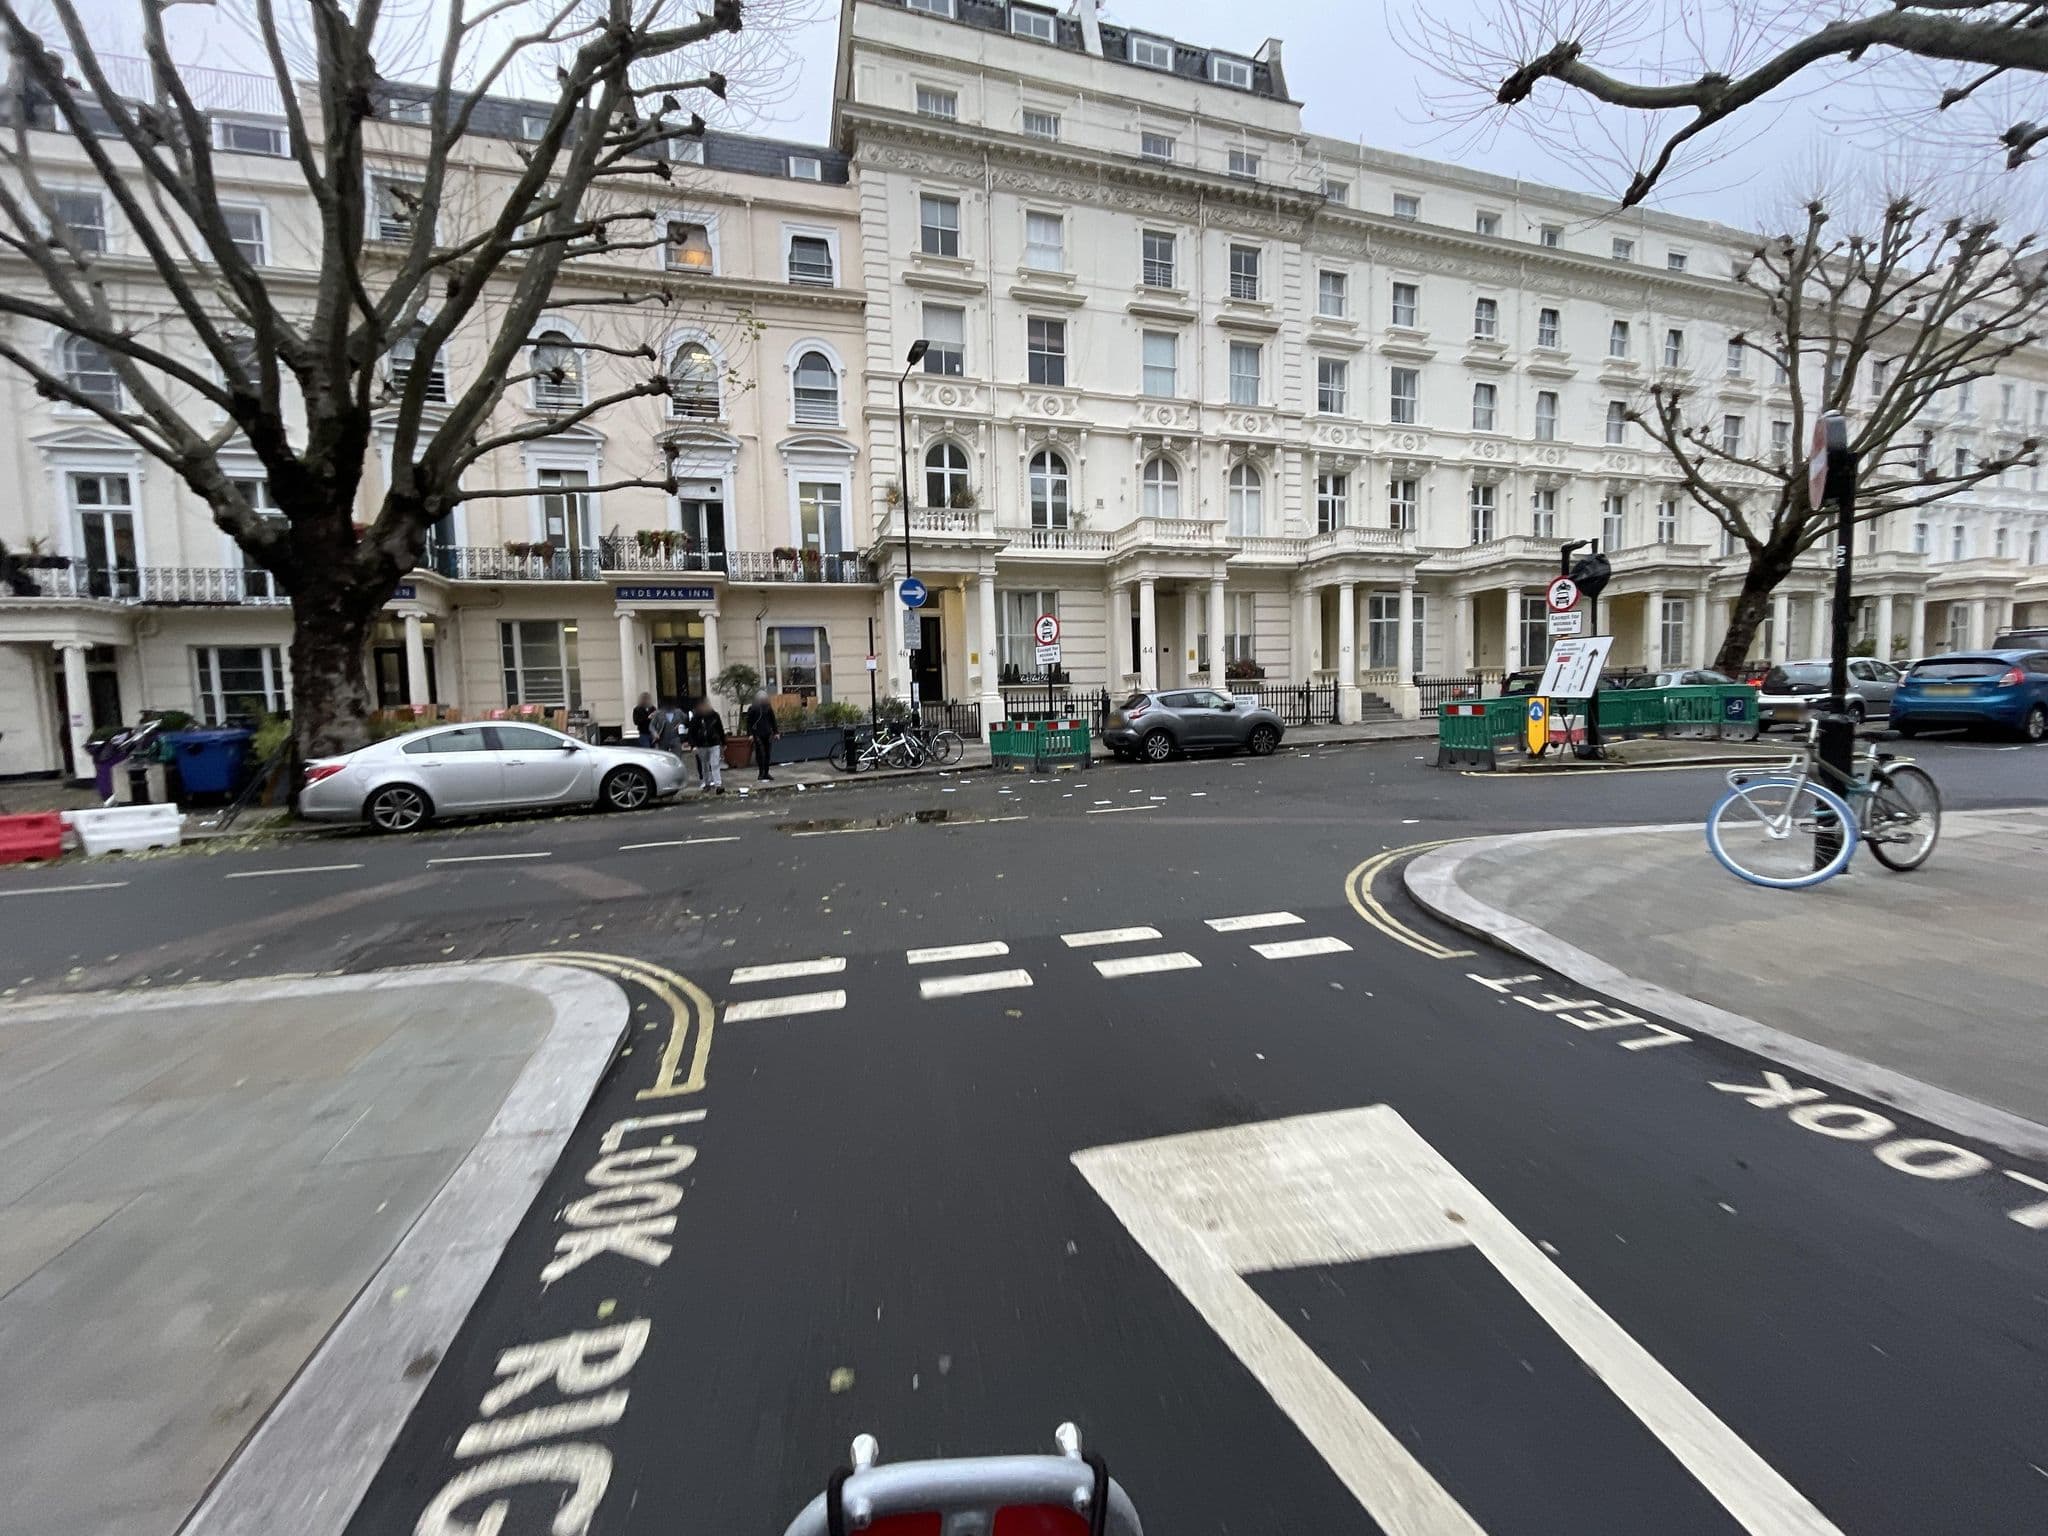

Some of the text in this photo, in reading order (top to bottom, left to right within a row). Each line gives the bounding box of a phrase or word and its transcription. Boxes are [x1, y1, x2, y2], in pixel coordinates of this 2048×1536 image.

[656, 589, 684, 598] PARK
[688, 589, 709, 597] INN
[1465, 973, 1693, 1050] LEFT
[540, 1108, 708, 1282] LOOK
